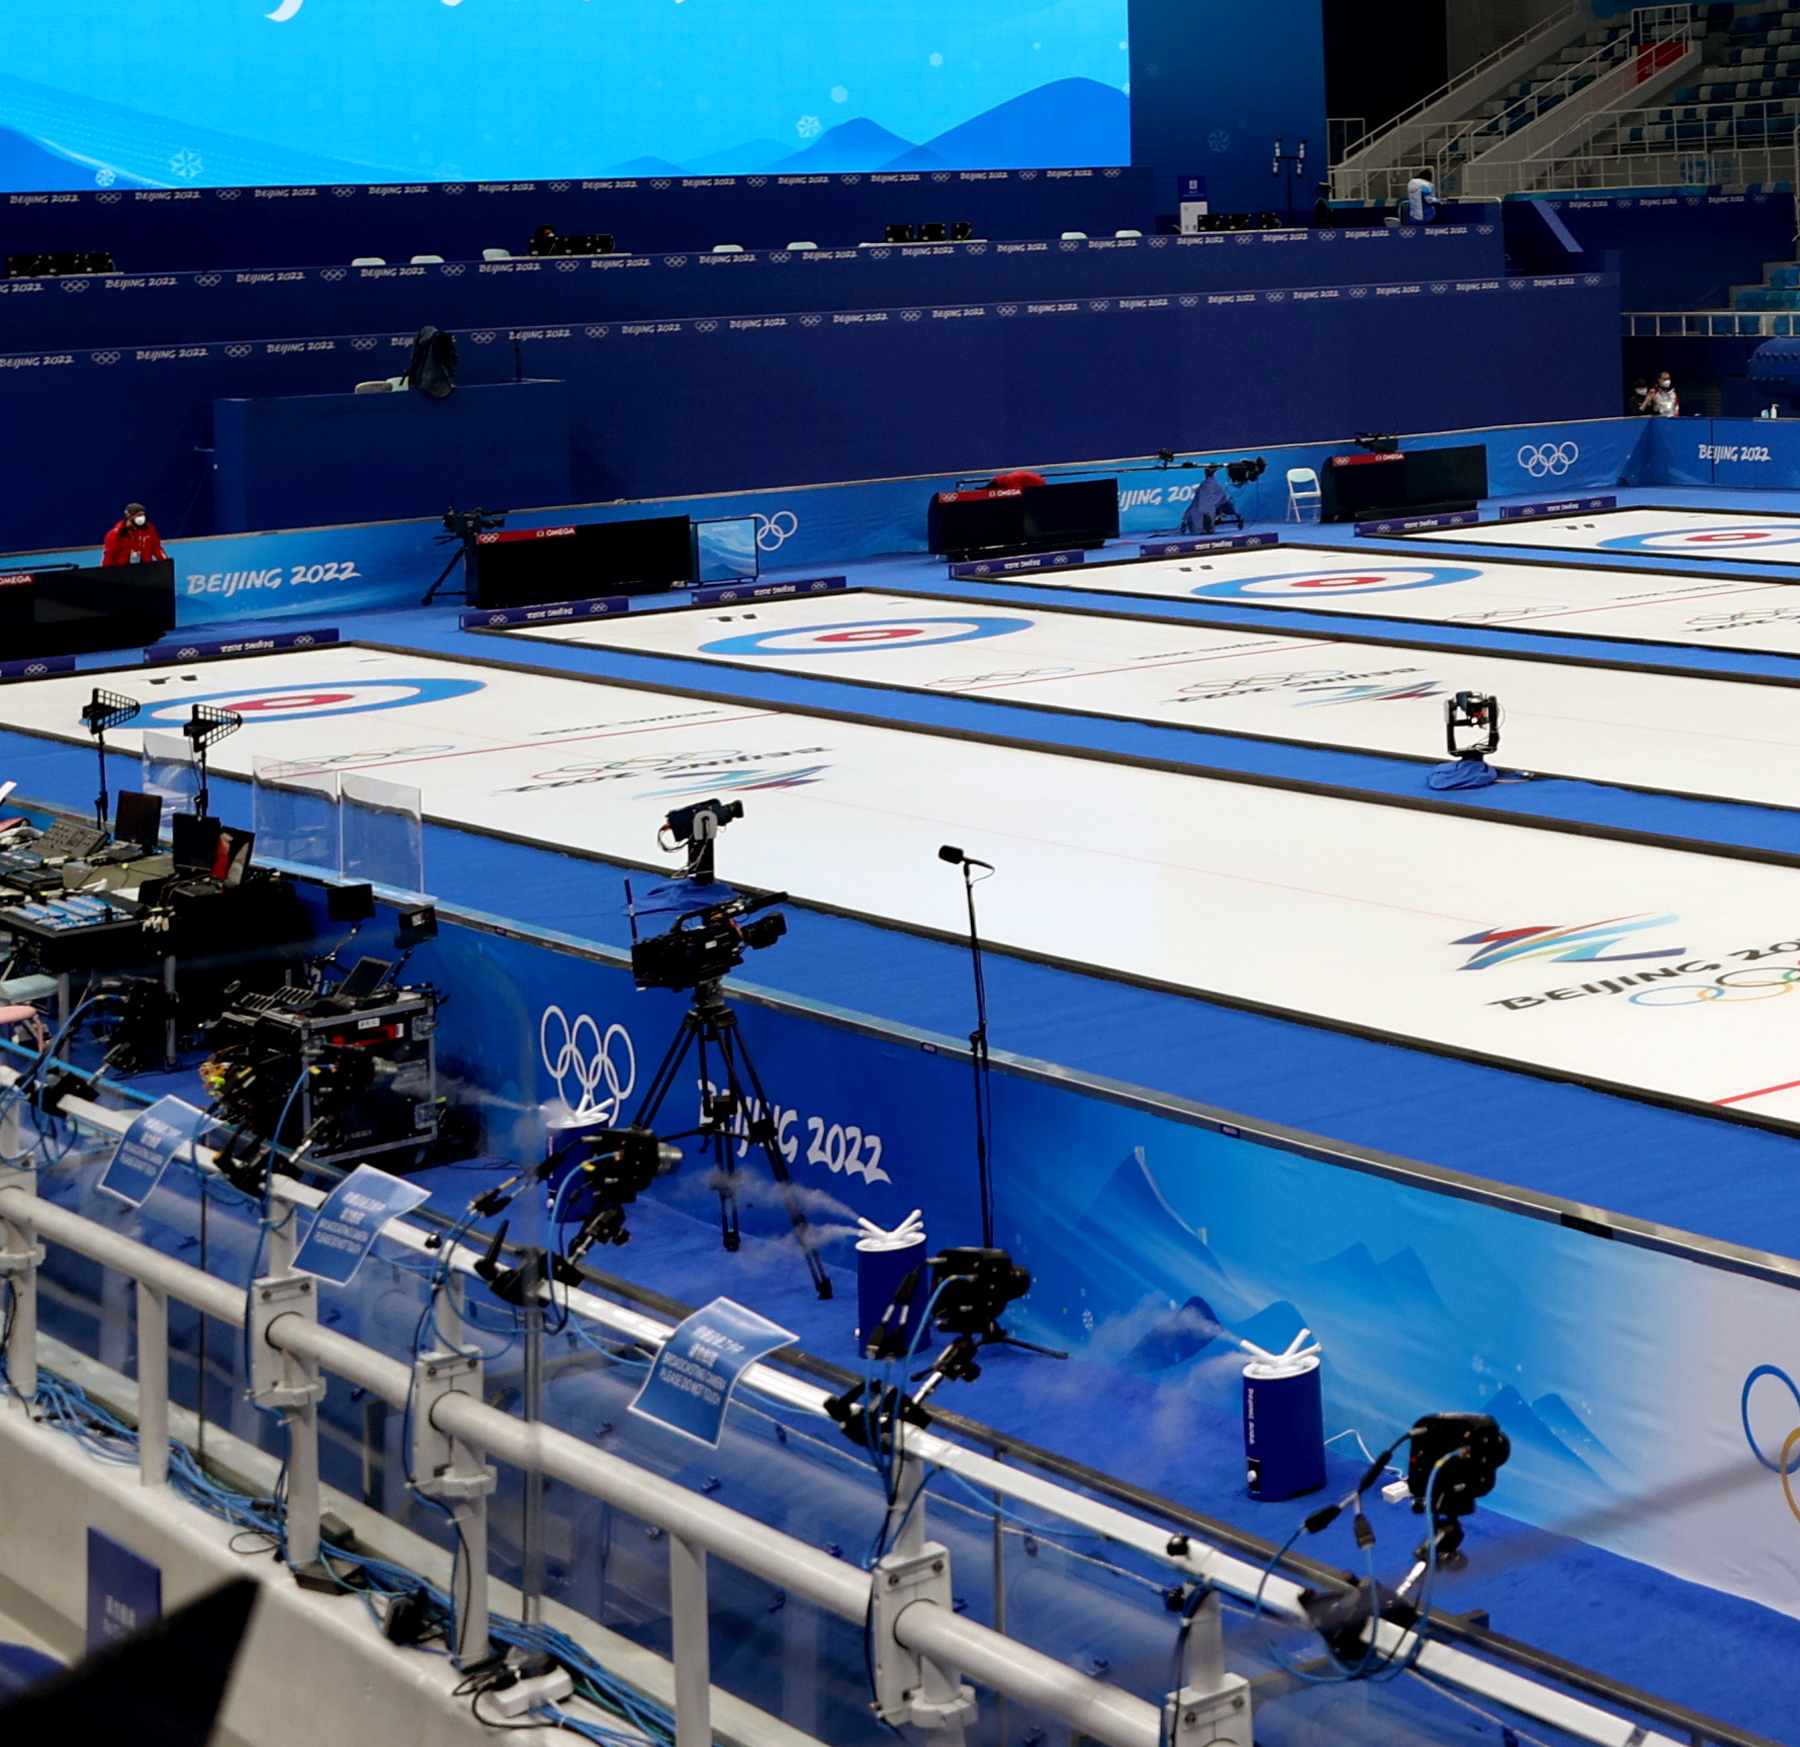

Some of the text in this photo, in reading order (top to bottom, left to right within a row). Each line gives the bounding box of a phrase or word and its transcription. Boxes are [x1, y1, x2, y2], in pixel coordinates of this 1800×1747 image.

[10, 195, 79, 205] BEIJING 2022
[106, 277, 177, 290] BEIJING 2022
[237, 272, 305, 284] BEIJING 2022
[136, 348, 208, 361] BEIJING 2022
[0, 355, 74, 369] BEIJING 2022
[1699, 444, 1771, 464] BEIJING 2022
[546, 528, 575, 536] OMEGA
[187, 562, 361, 597] BEIJING 2022
[1486, 959, 1722, 1012] BEIJING
[806, 1115, 893, 1185] 2022
